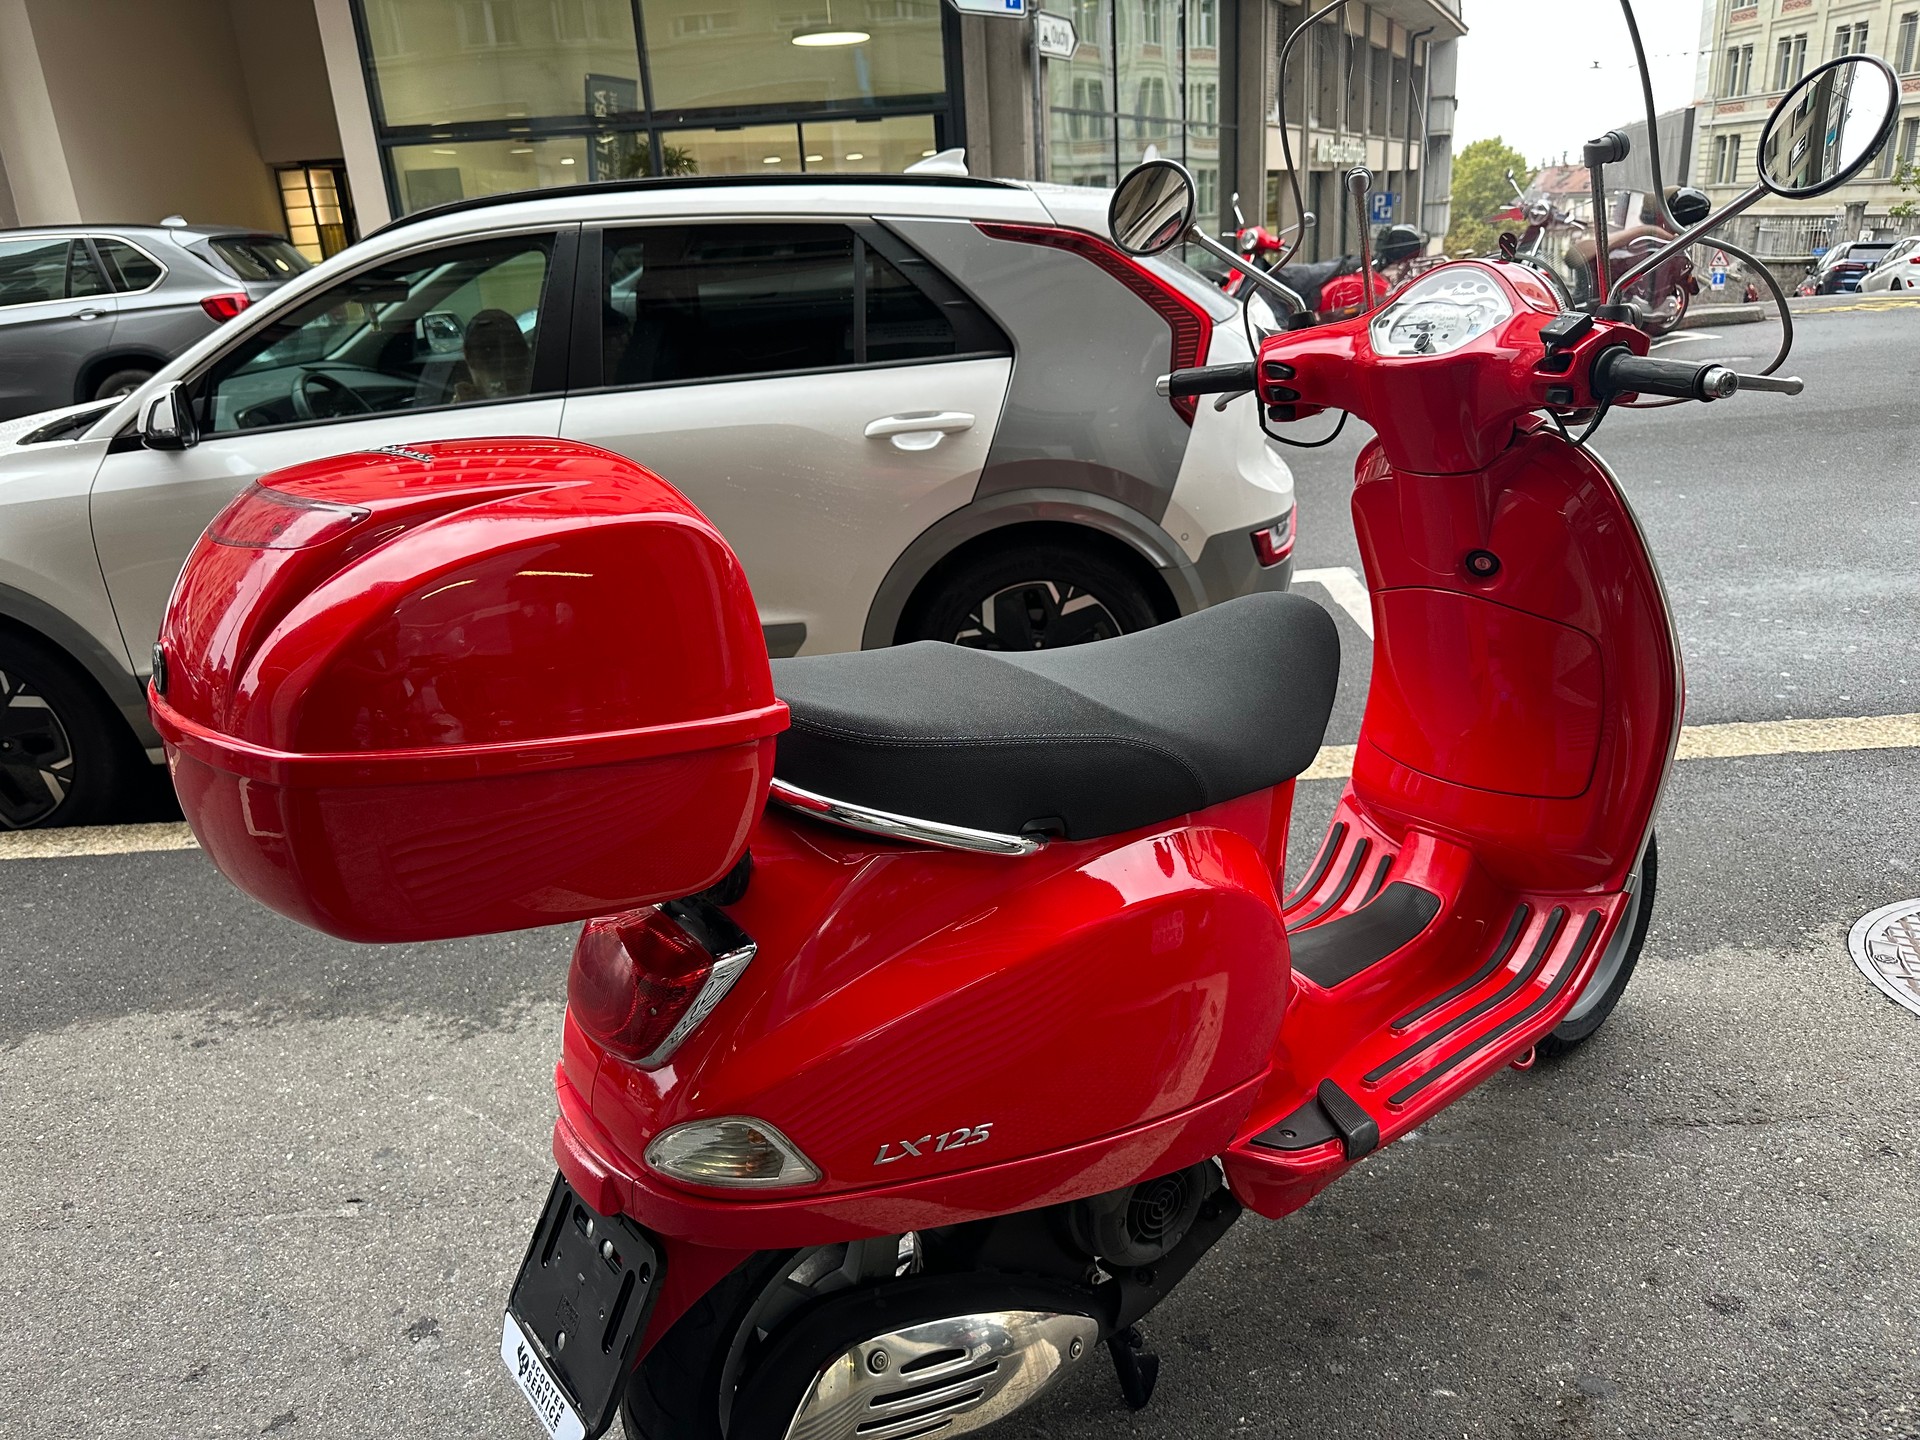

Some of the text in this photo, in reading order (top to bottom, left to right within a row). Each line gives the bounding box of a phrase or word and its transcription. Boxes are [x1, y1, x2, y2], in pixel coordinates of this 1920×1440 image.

[1050, 25, 1070, 51] Ouchy
[873, 1122, 994, 1166] LX 125
[526, 1369, 562, 1428] SERVICE
[530, 1359, 566, 1415] SCOOTER
